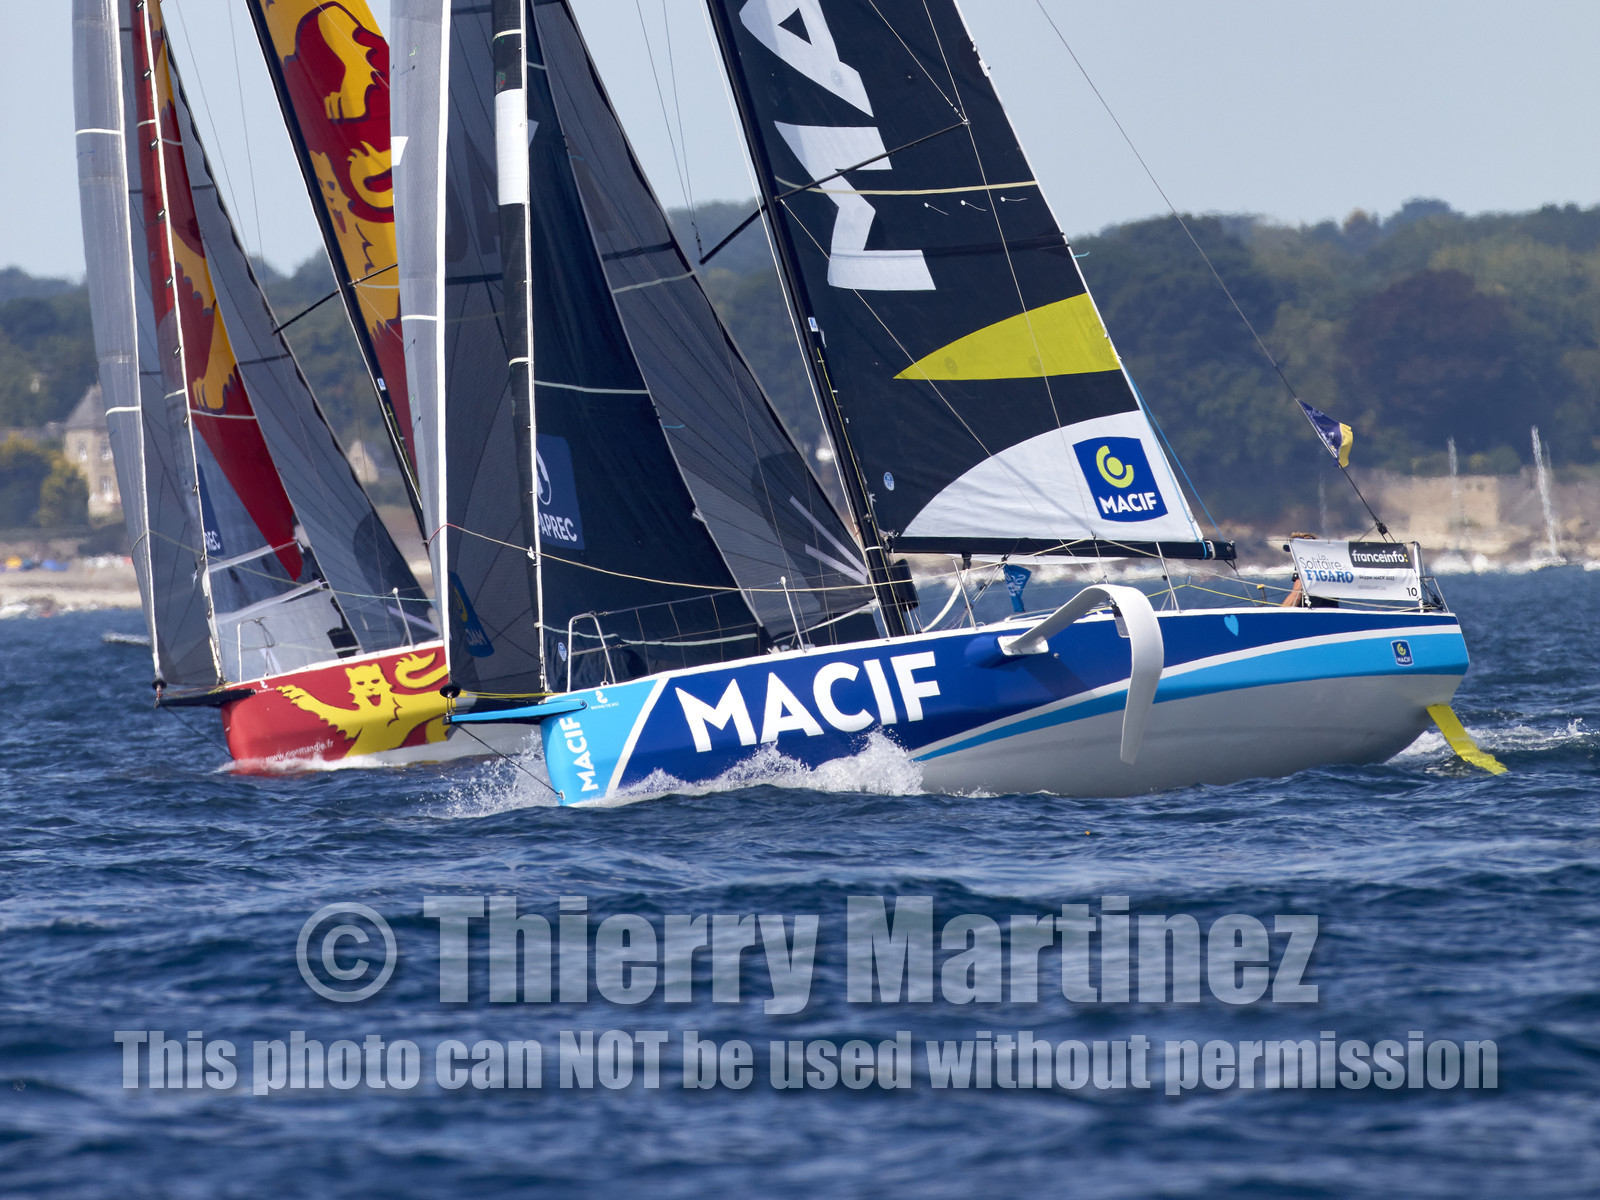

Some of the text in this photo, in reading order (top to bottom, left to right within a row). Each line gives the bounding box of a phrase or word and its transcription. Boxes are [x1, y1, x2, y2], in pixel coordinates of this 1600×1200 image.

[1098, 492, 1157, 514] MACIF
[1299, 556, 1343, 570] Solitaire
[1305, 569, 1354, 583] FIGARO
[1406, 587, 1418, 597] 10
[675, 651, 941, 753] MACIF
[559, 717, 599, 792] MACIF
